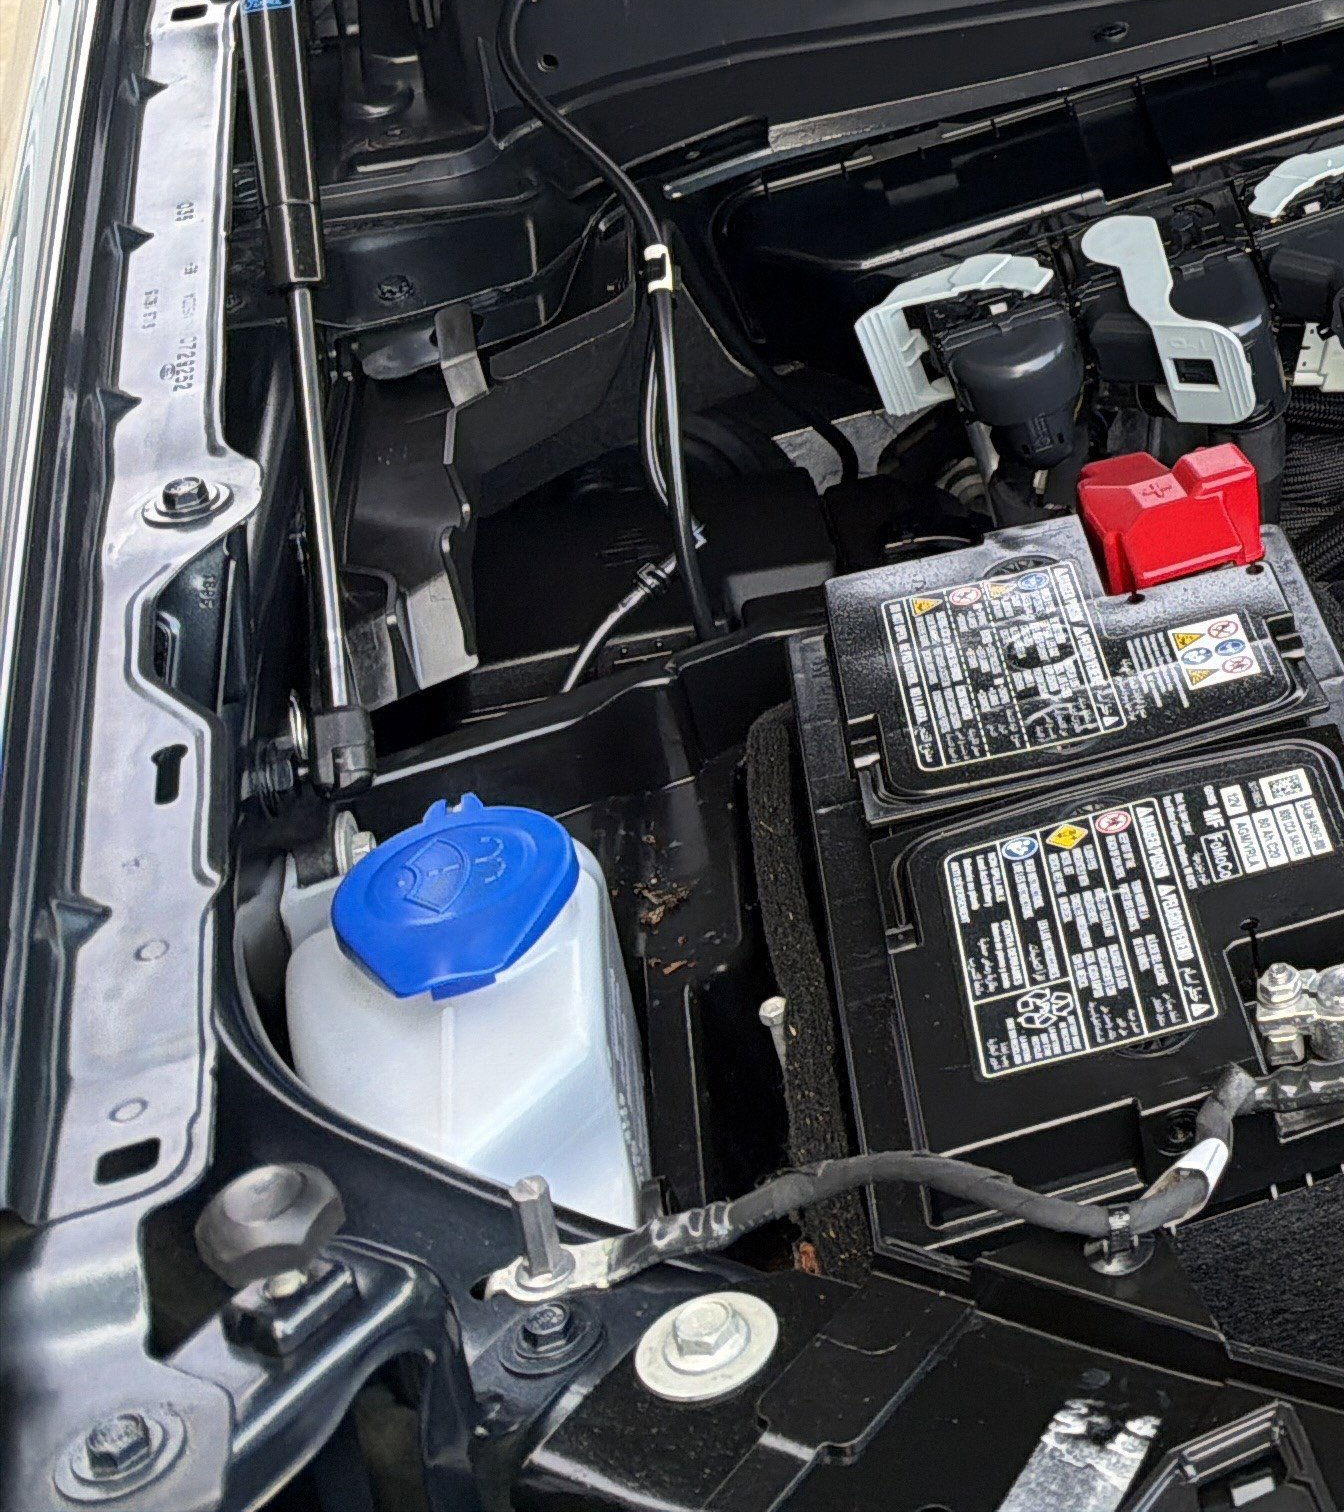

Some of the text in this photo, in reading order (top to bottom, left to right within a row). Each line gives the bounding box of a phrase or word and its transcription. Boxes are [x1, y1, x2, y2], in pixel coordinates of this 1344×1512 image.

[1202, 807, 1225, 830] MF
[1226, 792, 1241, 809] 12V
[1207, 834, 1234, 878] FoMoCo
[1235, 821, 1260, 867] AGM/VRLA
[1257, 817, 1280, 859] 80 Ah C20
